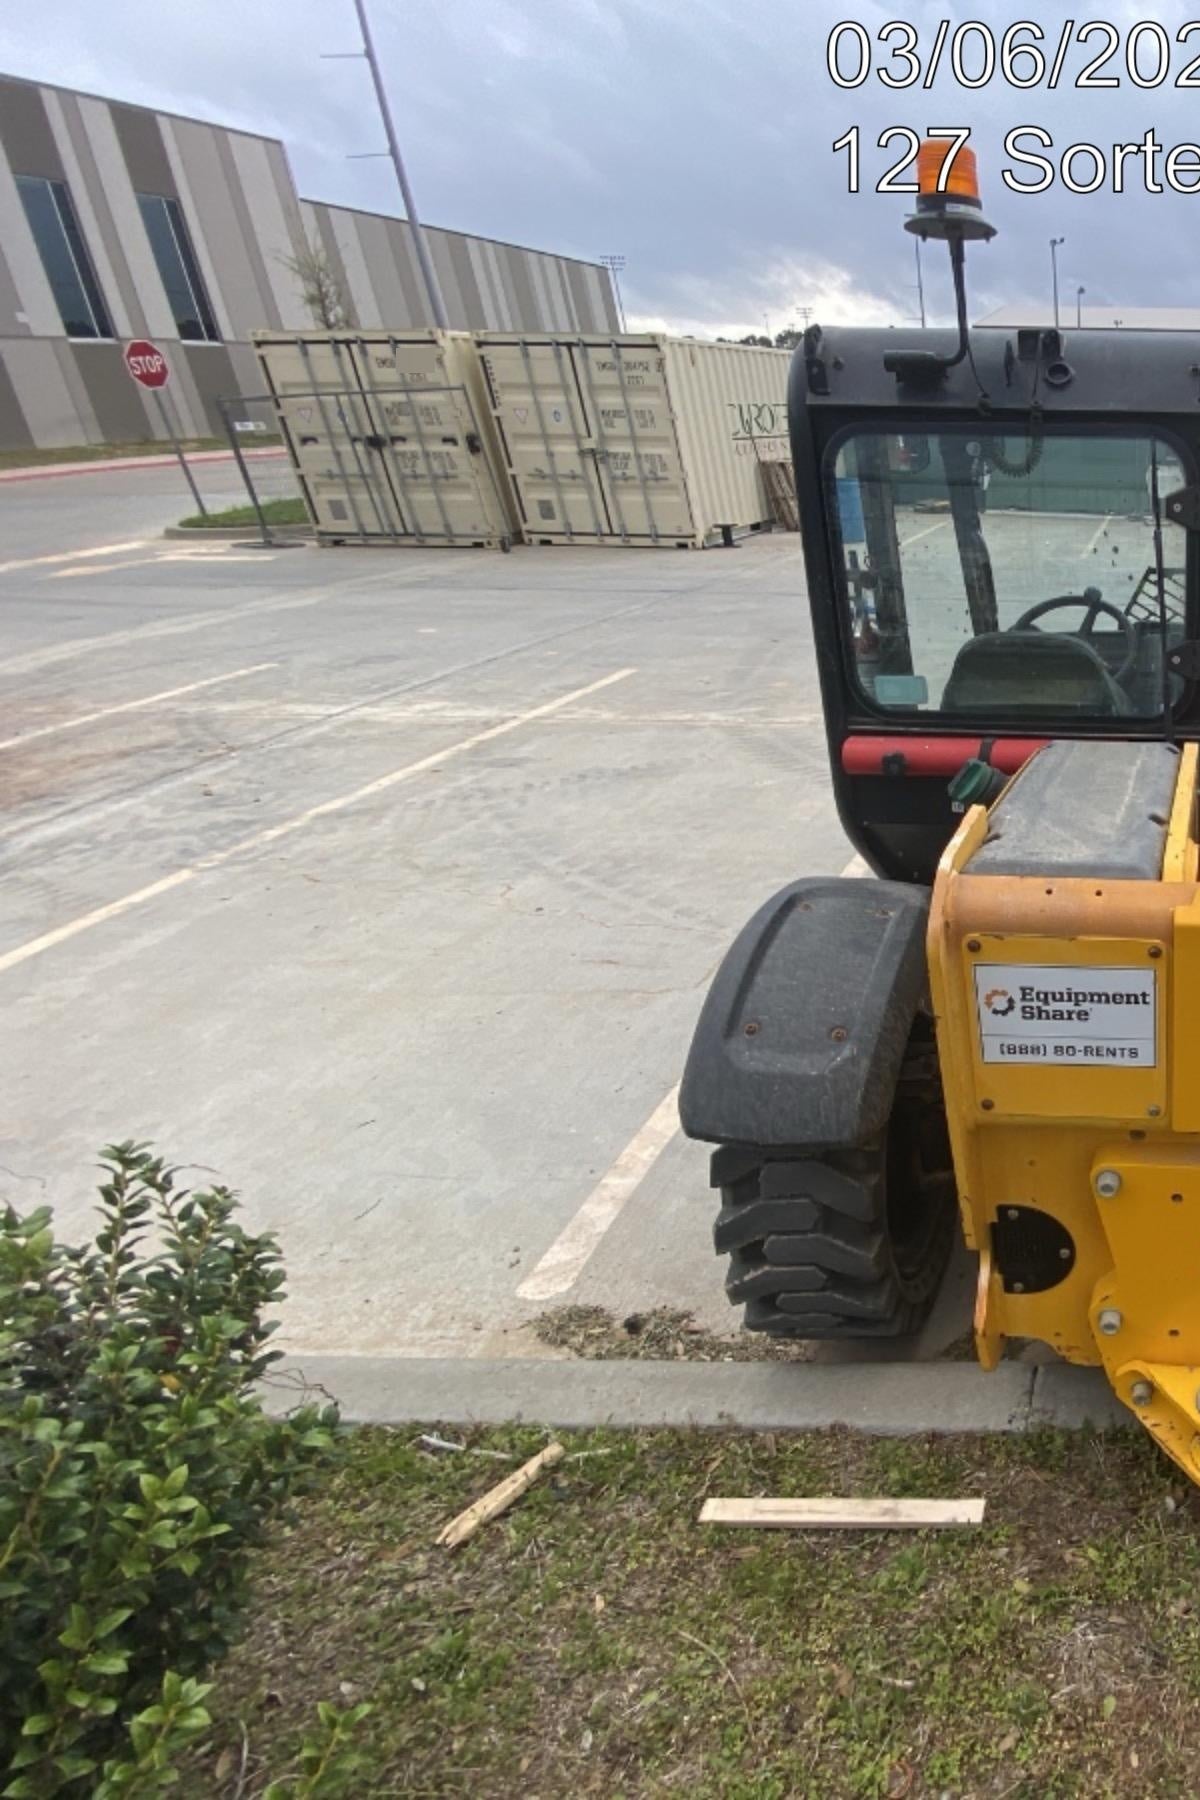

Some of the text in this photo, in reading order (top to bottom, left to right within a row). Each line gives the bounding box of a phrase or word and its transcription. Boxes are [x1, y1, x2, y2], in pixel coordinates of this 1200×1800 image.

[130, 355, 163, 375] STOP
[1019, 985, 1150, 1007] Equipment
[1021, 1004, 1090, 1021] Share
[1053, 1044, 1139, 1059] 80-RENTS
